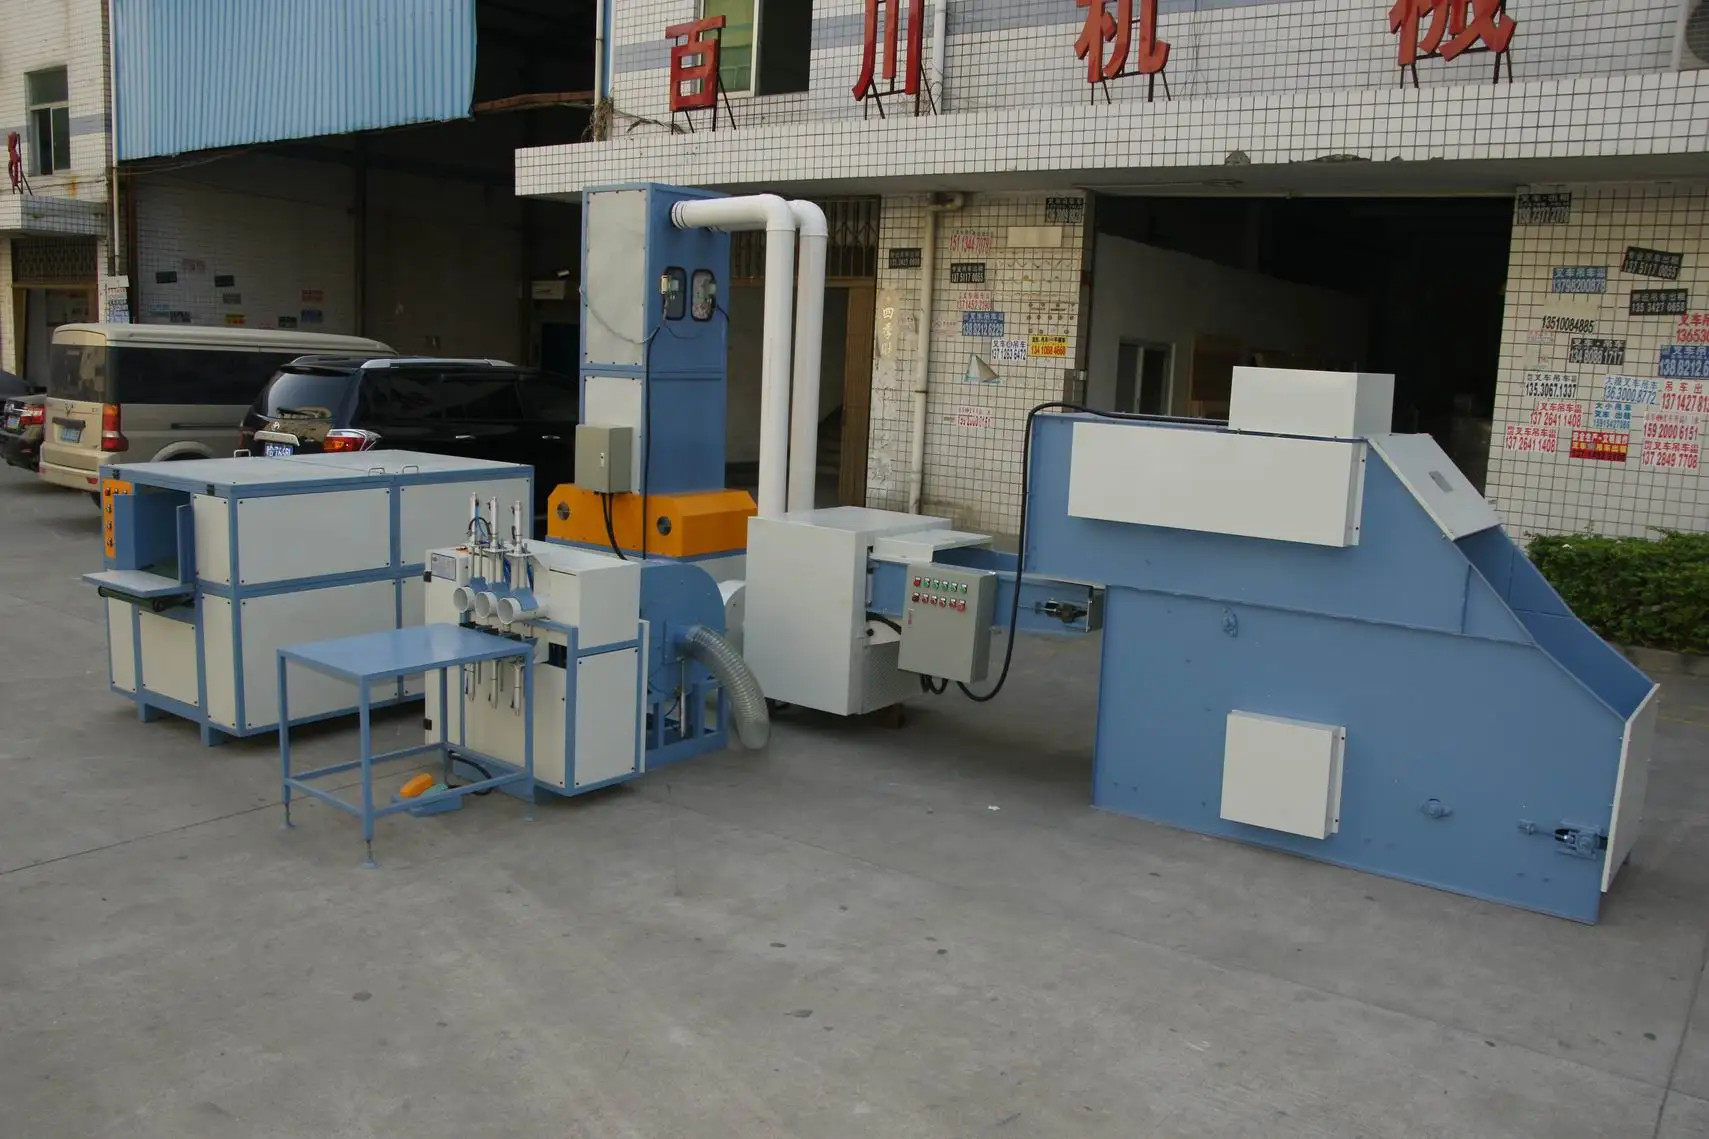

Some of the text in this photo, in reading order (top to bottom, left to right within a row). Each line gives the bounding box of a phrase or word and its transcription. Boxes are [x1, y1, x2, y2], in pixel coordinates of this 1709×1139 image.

[1526, 382, 1577, 398] 135.3067.1337
[1530, 411, 1582, 428] 137 2641 1408
[1505, 436, 1556, 453] 137 2641 1408
[1642, 451, 1654, 465] 137
